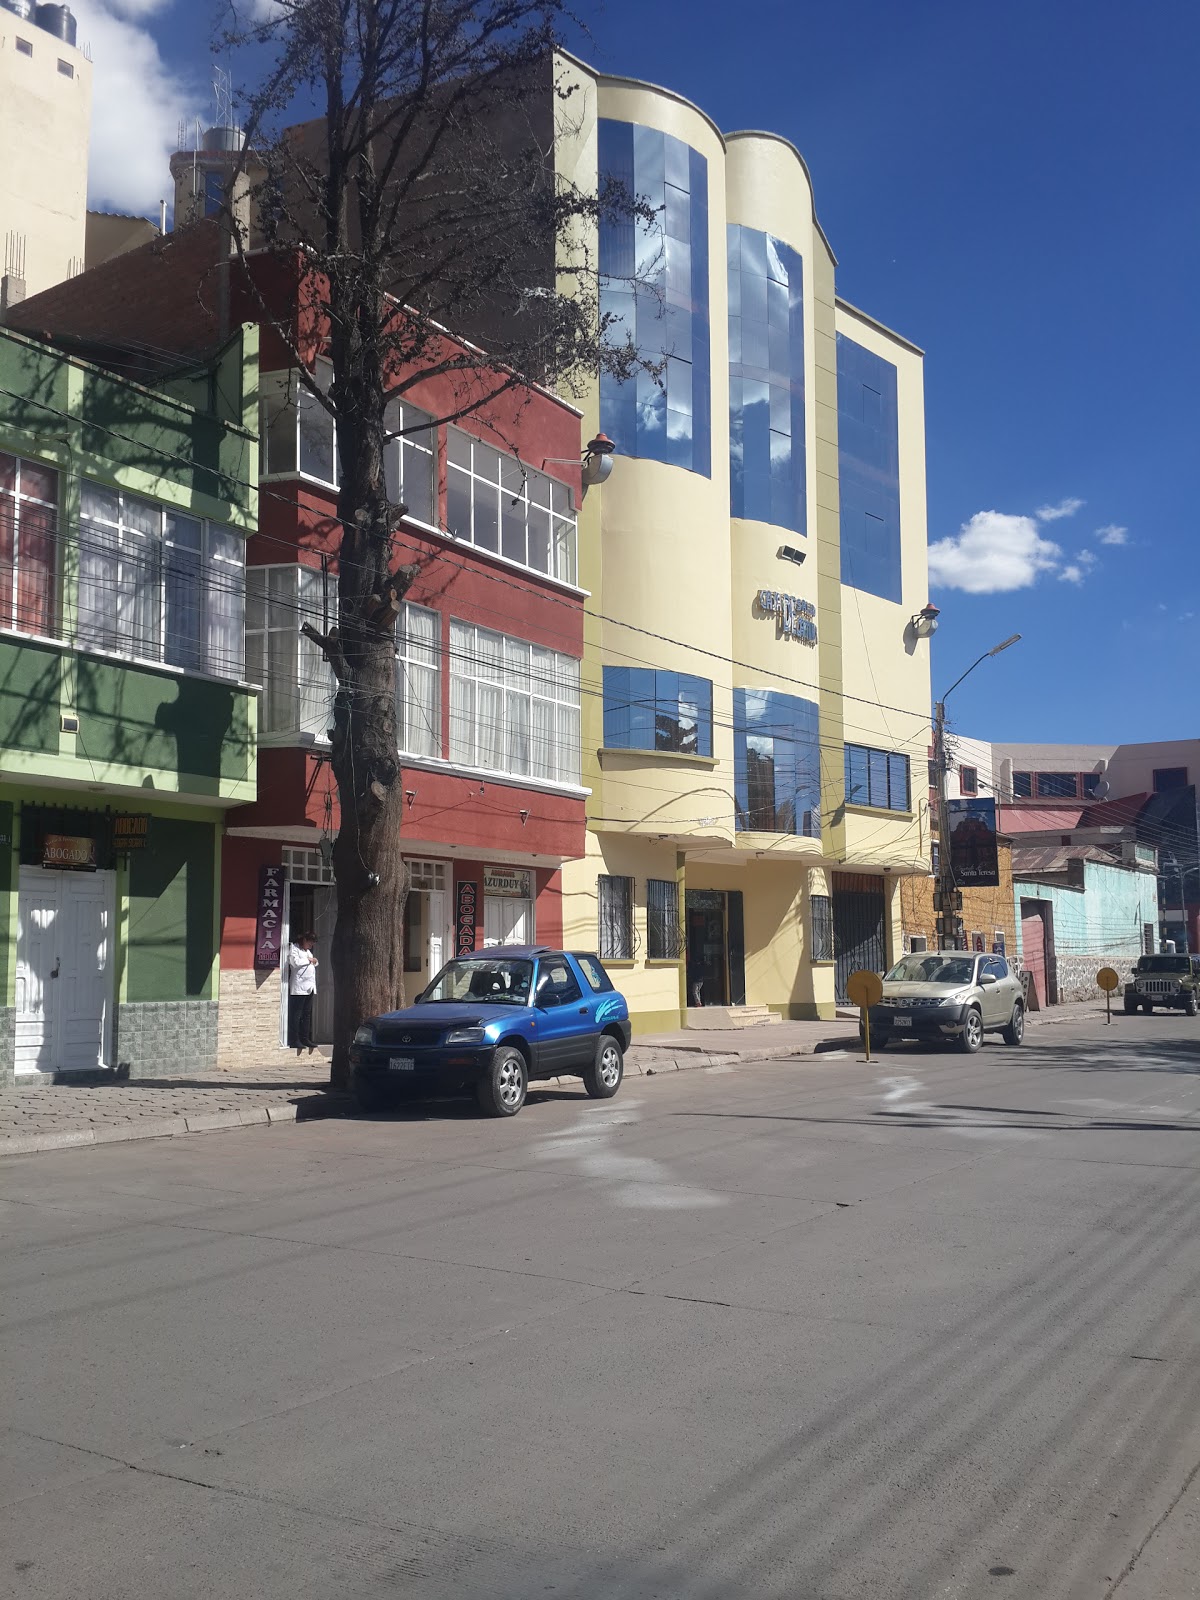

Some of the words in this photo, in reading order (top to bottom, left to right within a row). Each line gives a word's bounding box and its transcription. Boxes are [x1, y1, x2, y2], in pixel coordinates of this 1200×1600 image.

[43, 847, 88, 861] ABOGADO
[485, 876, 519, 889] AZURDUY
[262, 868, 279, 949] FARMACIA
